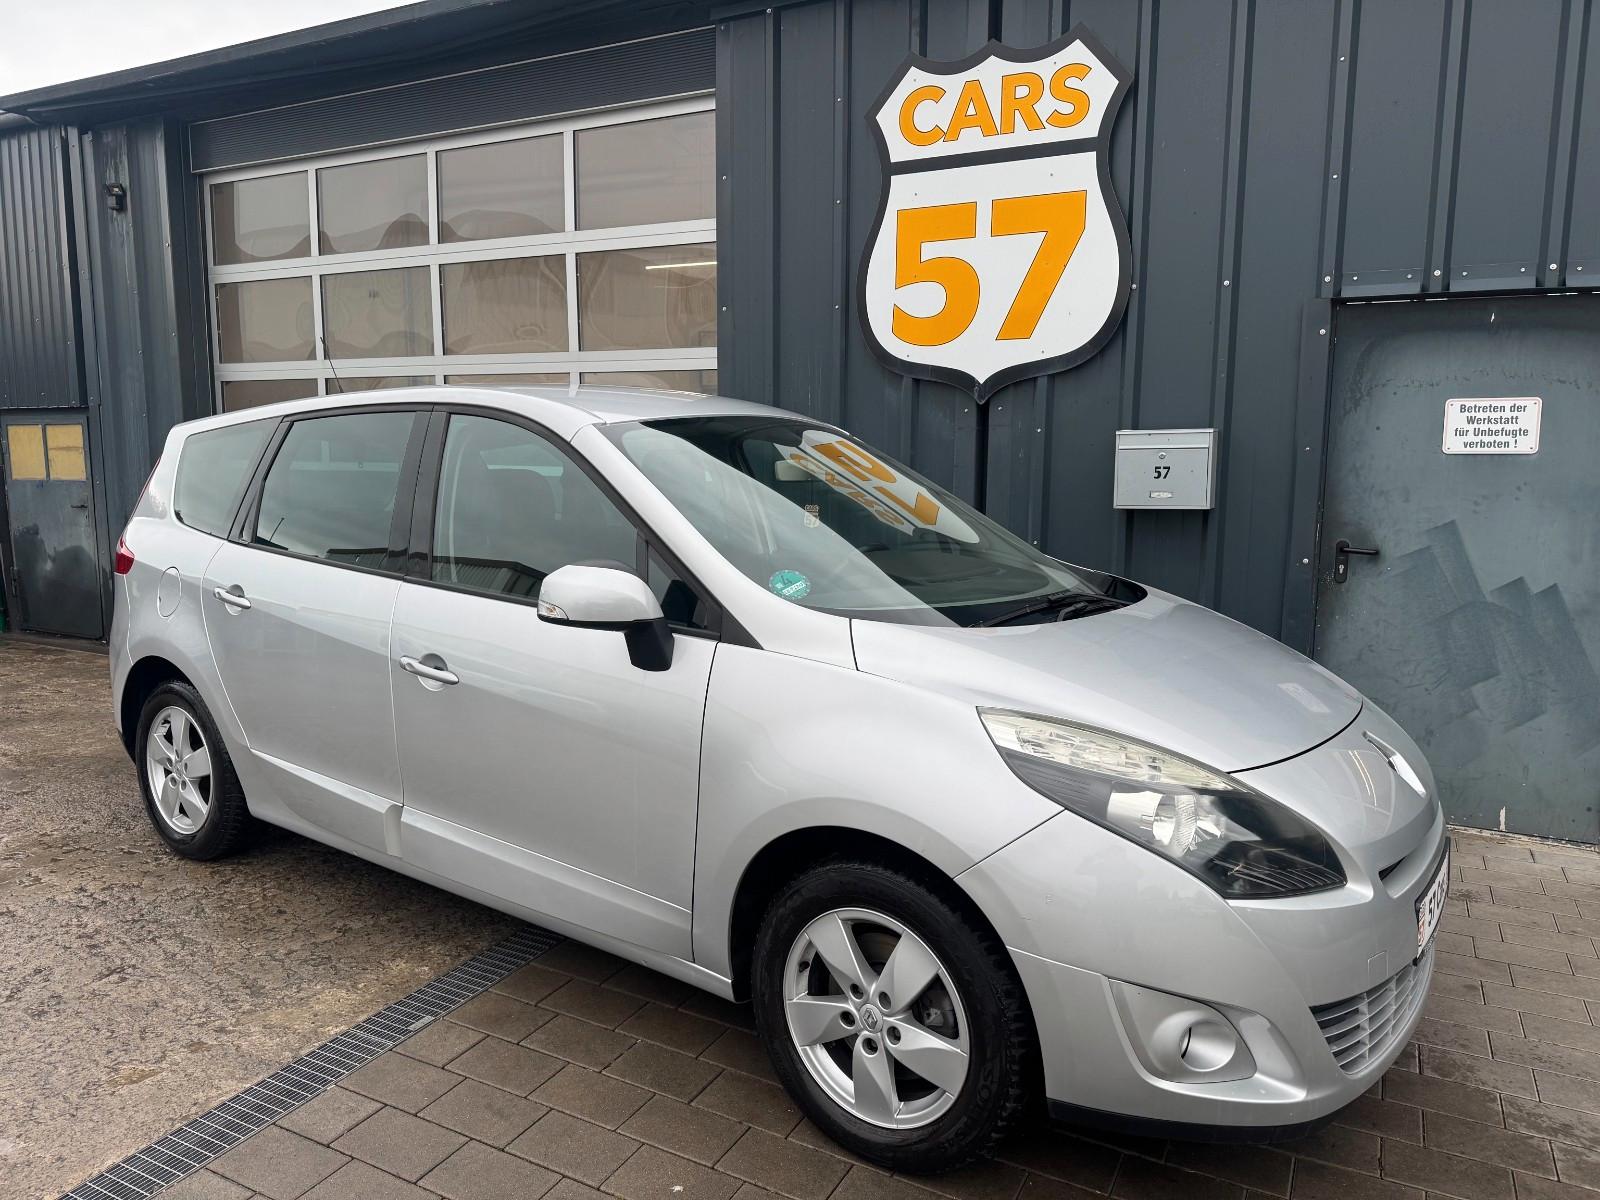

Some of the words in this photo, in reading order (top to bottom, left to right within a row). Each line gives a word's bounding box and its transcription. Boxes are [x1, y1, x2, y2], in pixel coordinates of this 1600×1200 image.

[899, 62, 1092, 146] CARS
[892, 189, 1087, 346] 57
[1459, 403, 1506, 414] Betreten
[1509, 403, 1528, 413] der
[1466, 415, 1520, 425] Werkstatt
[1454, 427, 1470, 437] für
[1473, 427, 1529, 438] Unbefugte
[1463, 439, 1510, 449] verboten
[1153, 465, 1171, 480] 57
